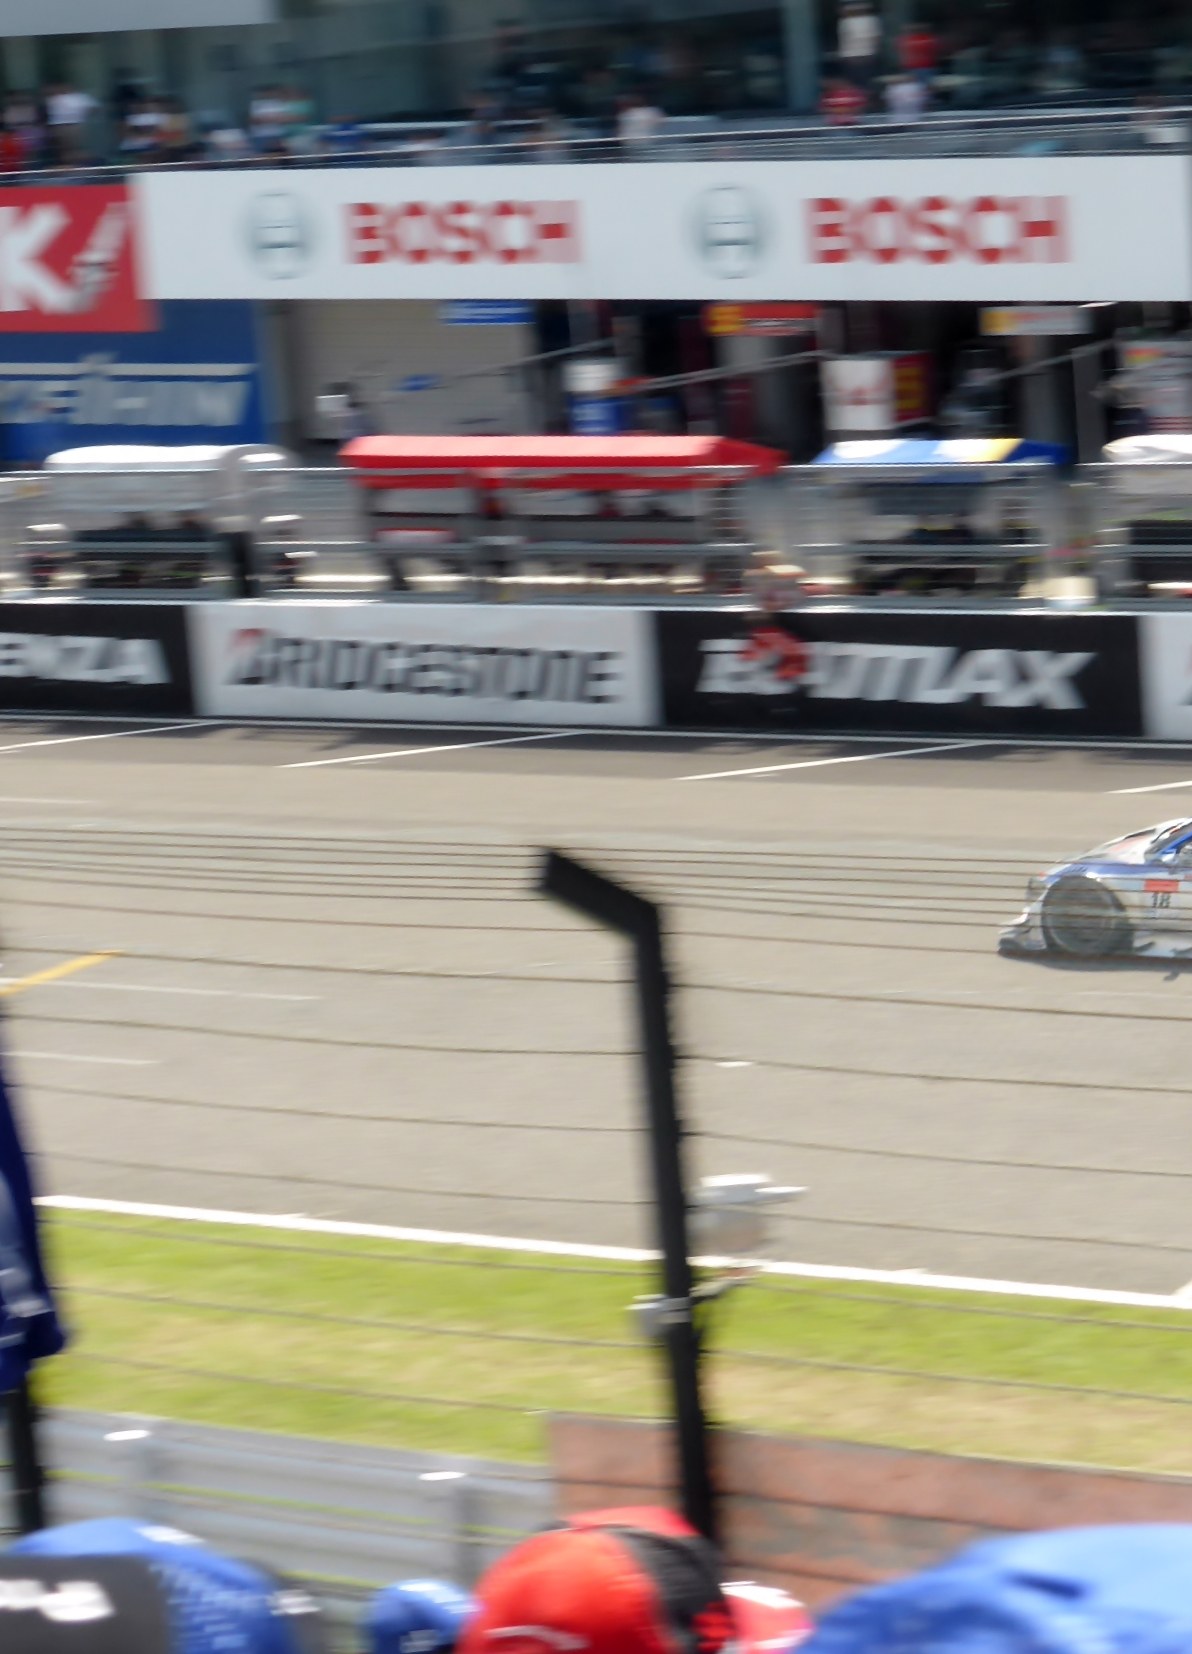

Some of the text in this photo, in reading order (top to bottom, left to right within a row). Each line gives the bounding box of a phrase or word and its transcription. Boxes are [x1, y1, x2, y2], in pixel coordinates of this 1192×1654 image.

[348, 200, 578, 265] BOSCH
[805, 196, 1072, 264] BOSCH
[226, 628, 624, 704] BRIDGESTONE
